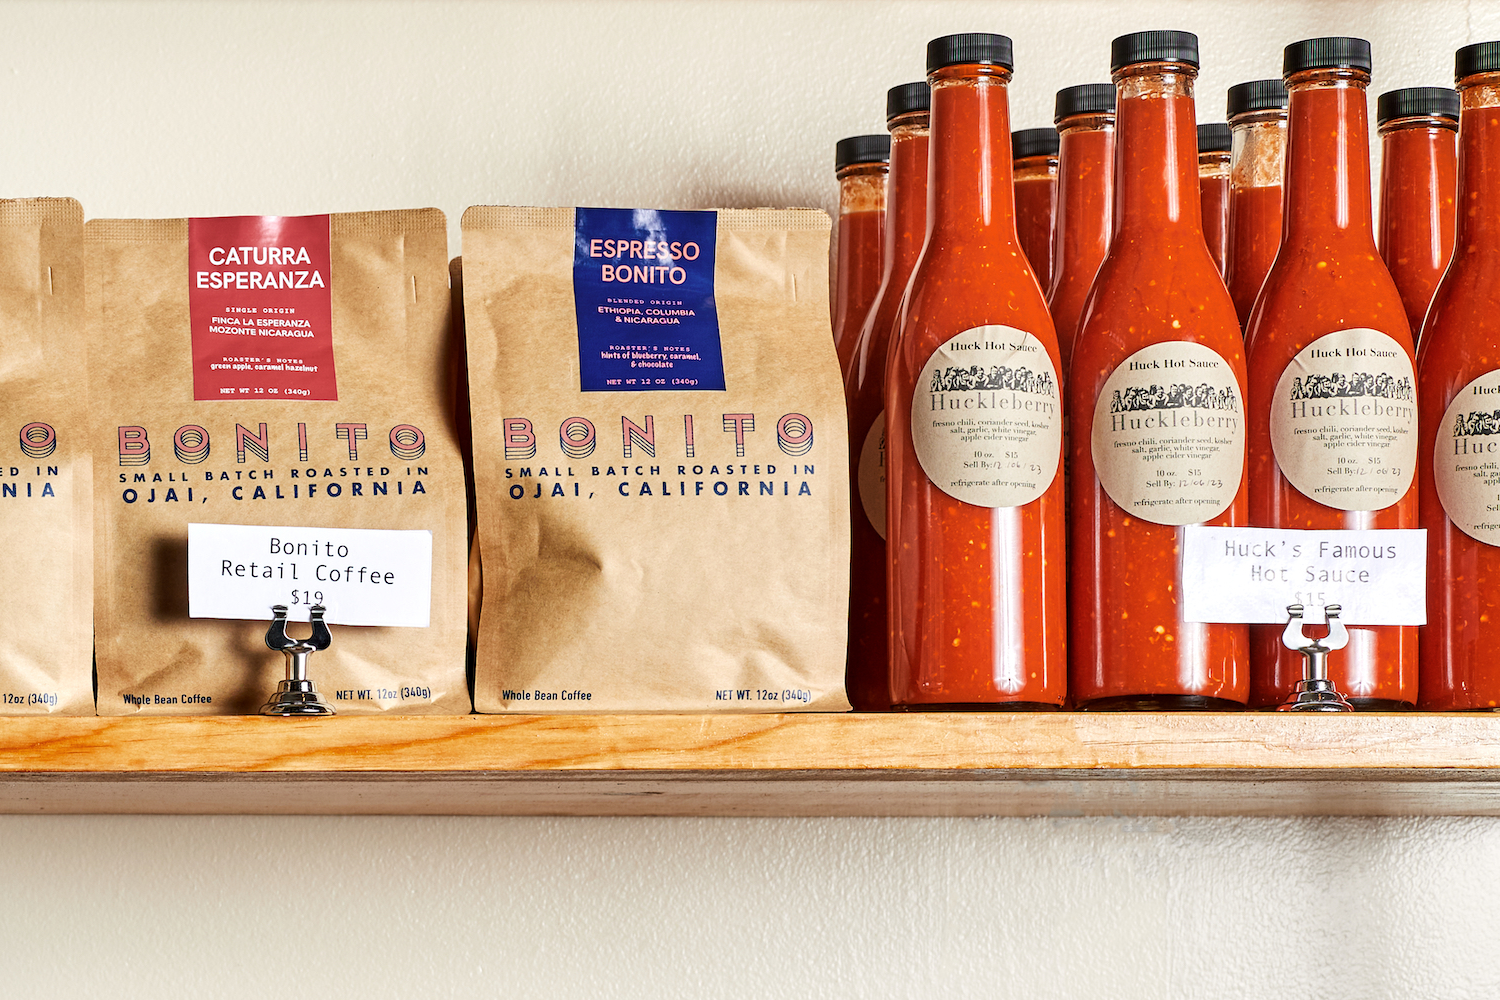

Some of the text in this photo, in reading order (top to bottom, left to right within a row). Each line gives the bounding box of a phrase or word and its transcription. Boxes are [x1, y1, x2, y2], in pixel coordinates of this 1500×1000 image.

[208, 246, 312, 266] CATURRA
[589, 238, 701, 262] ESPRESSO
[196, 270, 326, 290] ESPERANZA
[601, 264, 687, 285] BONITO
[208, 325, 315, 338] MOZONTE NICARAGUA
[211, 316, 311, 328] FINCA LA ESPERANZA
[950, 341, 1038, 353] Huck Hot Sauce
[929, 391, 1056, 421] Huckleberry
[117, 422, 427, 467] BONITO
[502, 412, 815, 461] BONITO
[950, 478, 1037, 490] refrigerate after opening
[269, 538, 350, 559] Bonito
[1224, 539, 1397, 560] Huck's Famous
[220, 559, 396, 586] Retail Coffee
[1250, 564, 1371, 584] Hot Sauce
[290, 588, 325, 607] $19
[1294, 590, 1326, 607] $15
